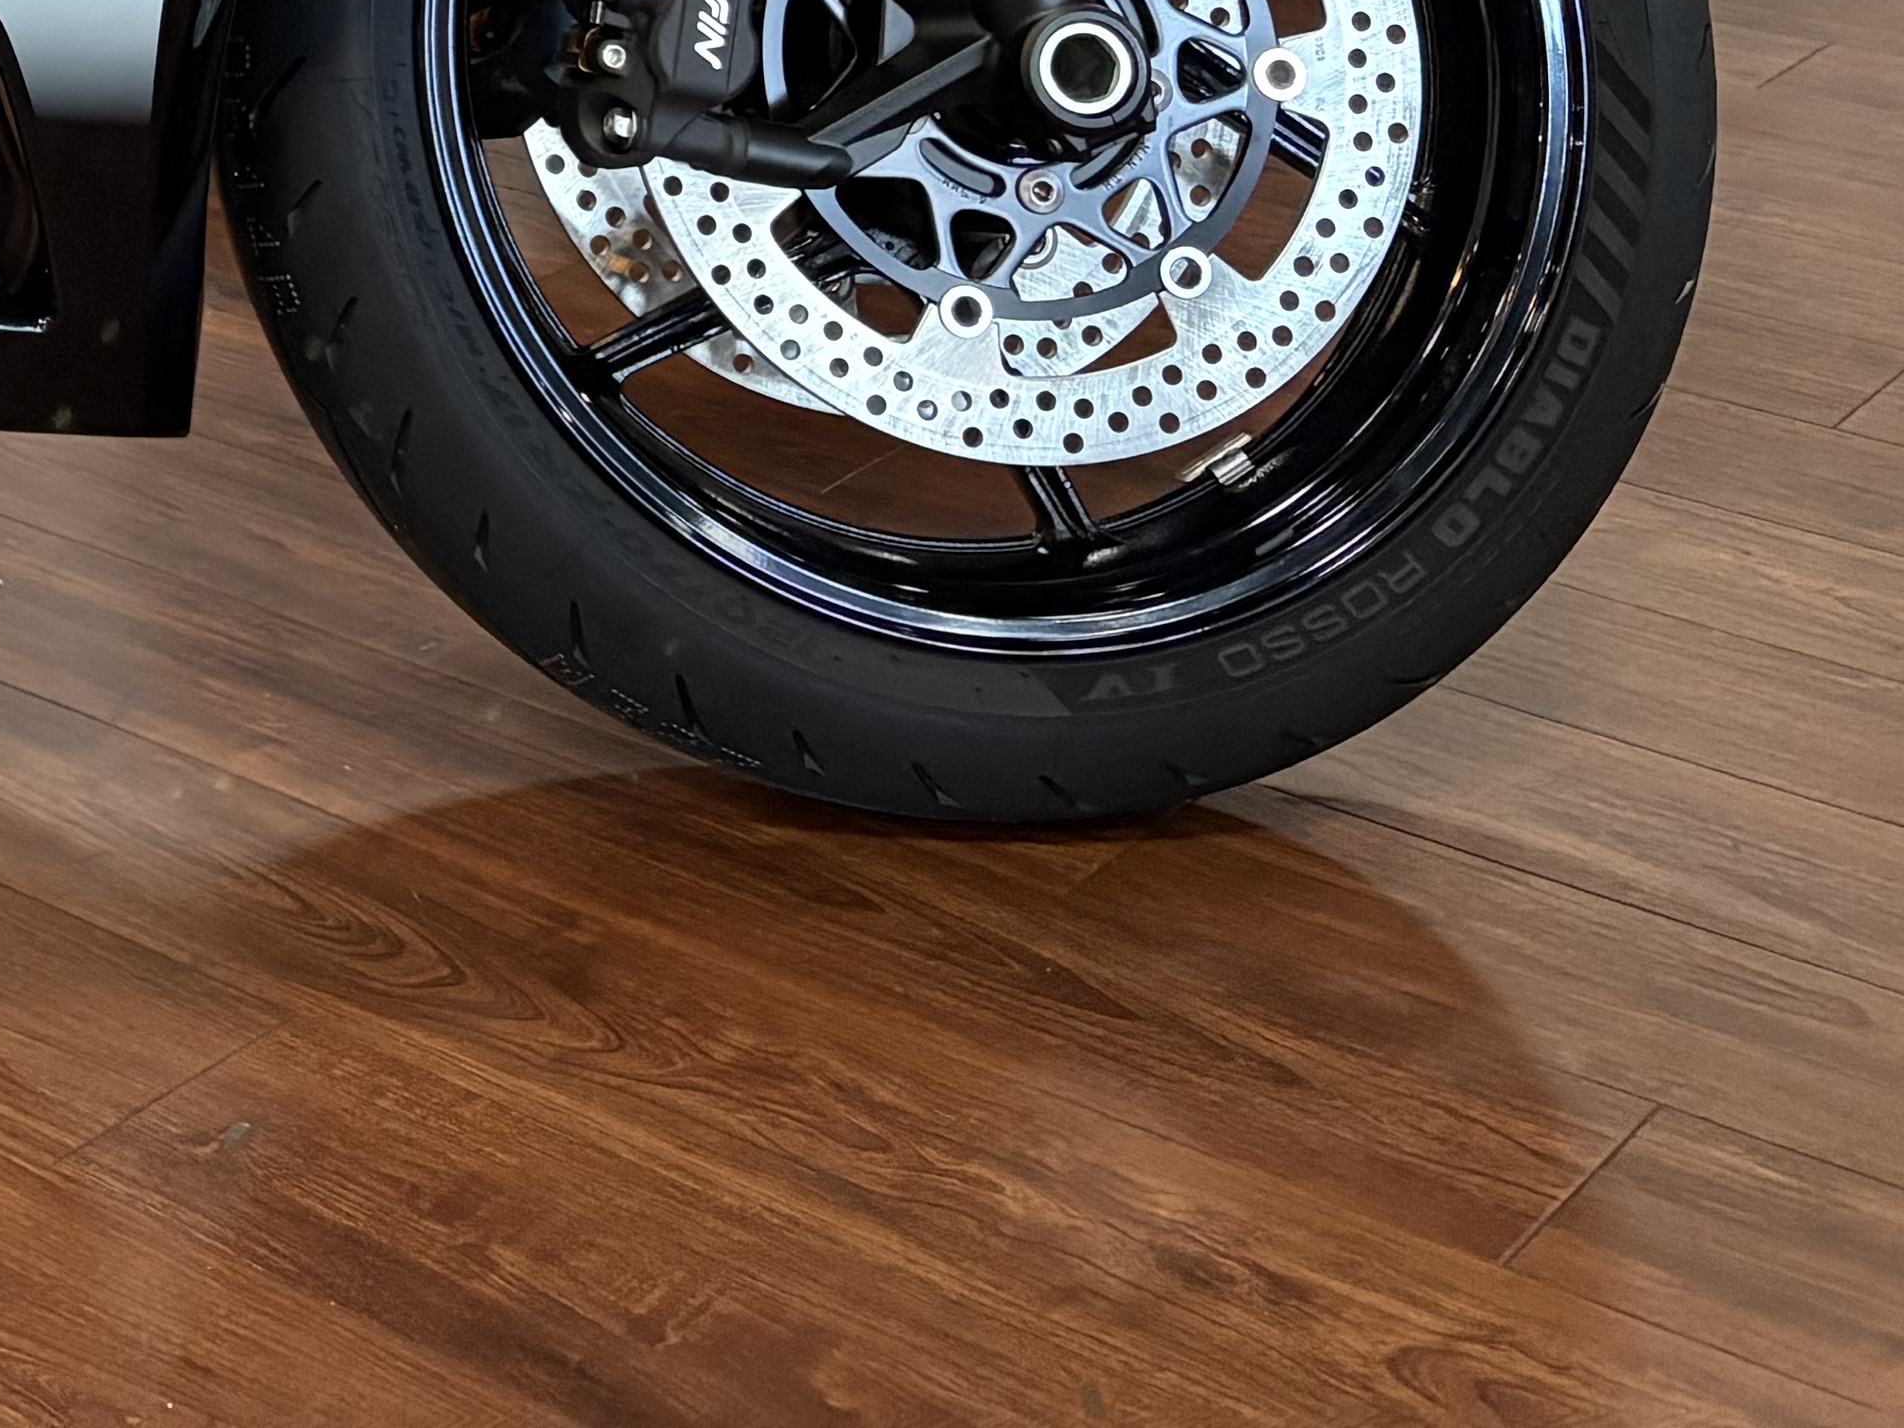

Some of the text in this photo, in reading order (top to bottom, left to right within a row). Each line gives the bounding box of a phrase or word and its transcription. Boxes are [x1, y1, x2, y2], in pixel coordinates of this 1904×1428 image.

[1080, 317, 1602, 702] DIABLO ROSSO IV
